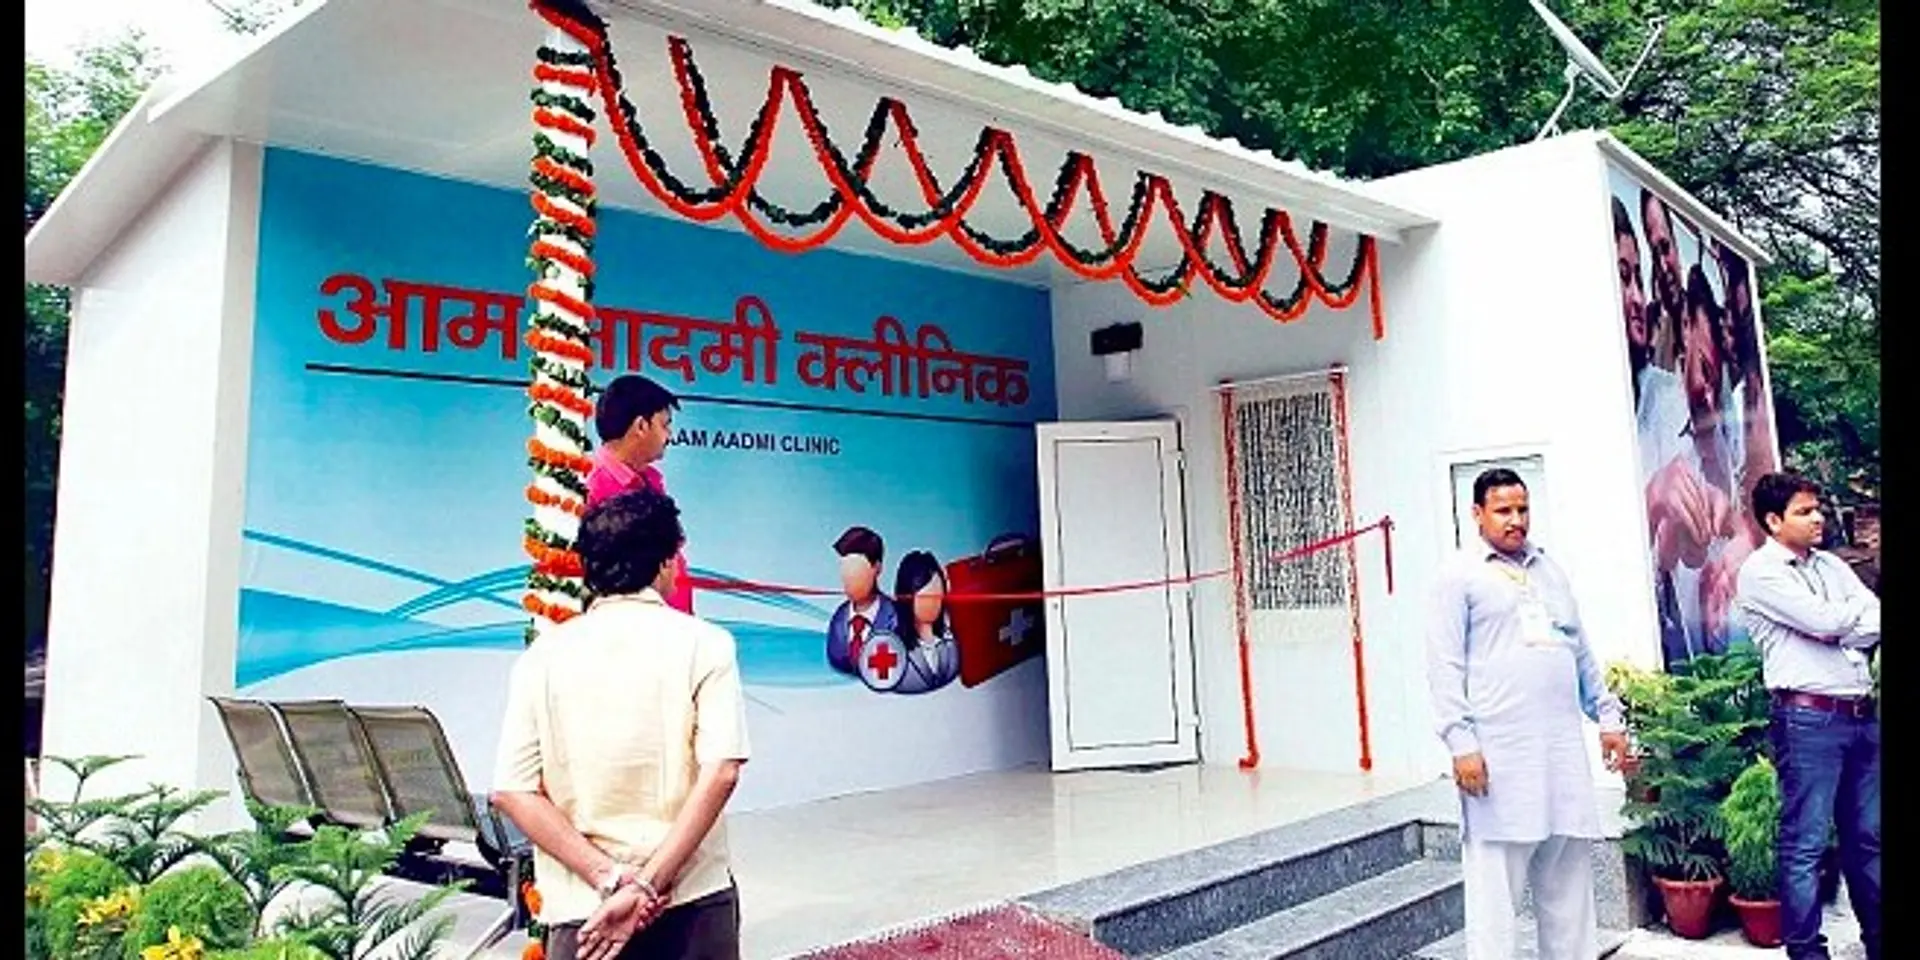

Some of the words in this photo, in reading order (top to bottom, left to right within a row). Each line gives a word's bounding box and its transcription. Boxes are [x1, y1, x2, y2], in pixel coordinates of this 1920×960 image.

[317, 273, 525, 360] आम
[795, 315, 1029, 407] क्लीनिक
[712, 430, 775, 451] AADMI
[780, 435, 841, 456] CLINIC
